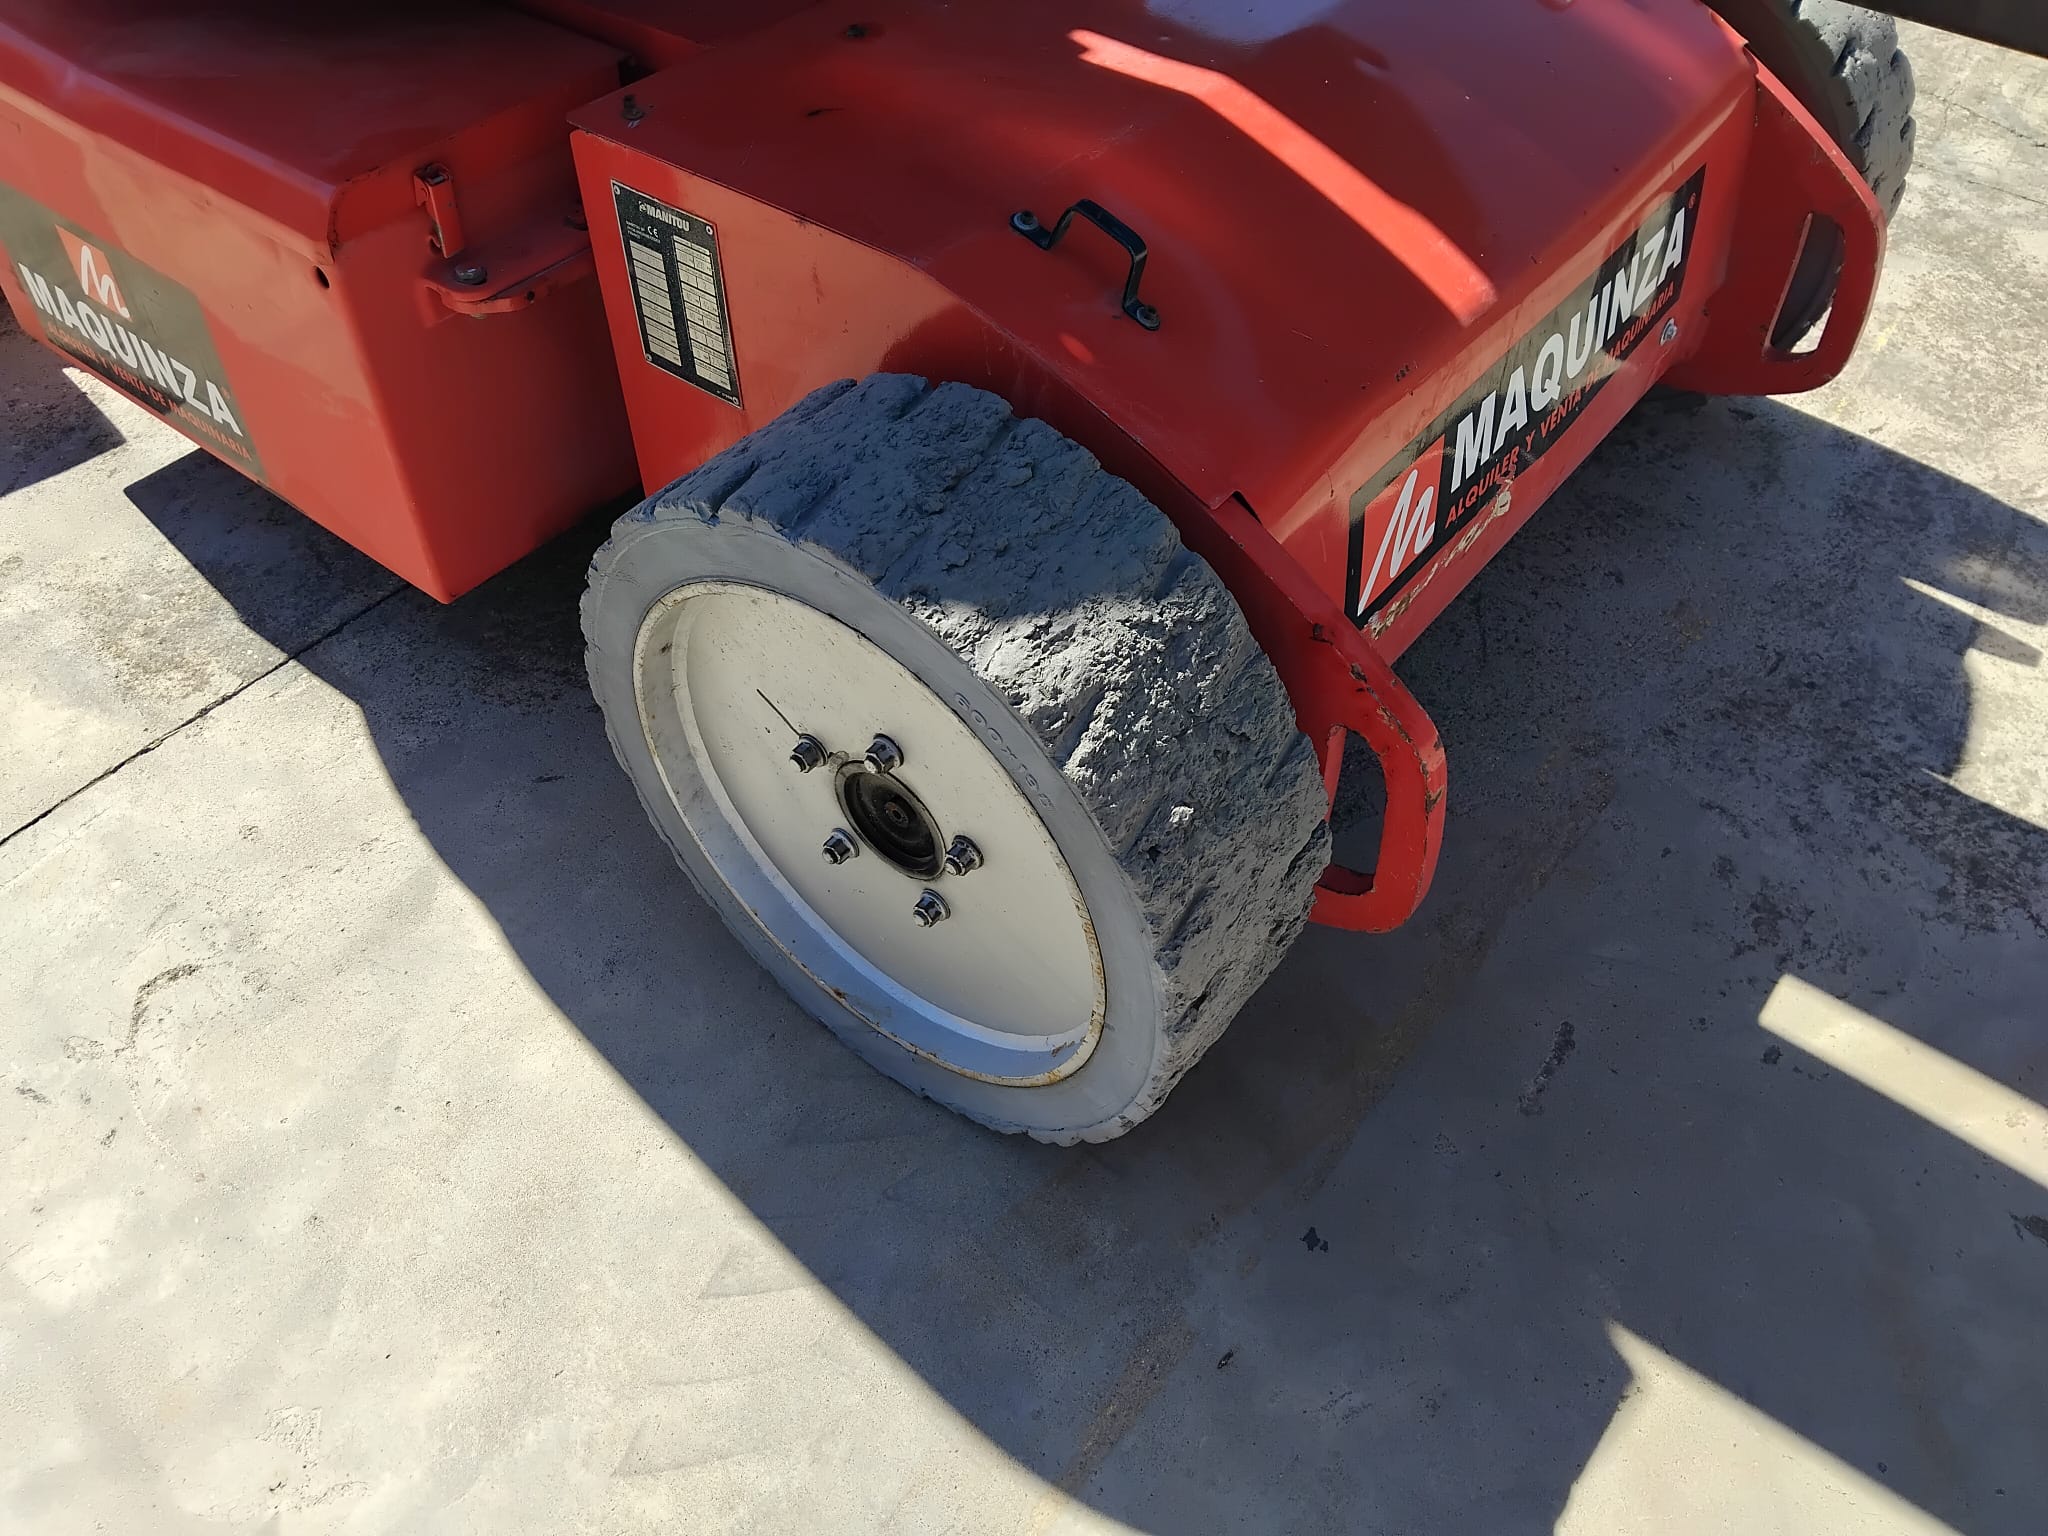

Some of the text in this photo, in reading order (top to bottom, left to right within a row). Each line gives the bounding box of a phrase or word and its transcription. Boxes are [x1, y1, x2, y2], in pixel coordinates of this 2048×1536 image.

[646, 204, 690, 231] MANITOU
[647, 226, 659, 238] CE
[18, 262, 243, 437] MAQUINZA
[112, 362, 149, 395] VENTA
[151, 388, 167, 406] DE
[169, 400, 253, 461] MAQUINARIA
[1446, 446, 1519, 529] ALQUILER
[1525, 429, 1536, 452] Y
[1540, 392, 1582, 439] VENTA
[1605, 281, 1675, 362] MAQUINARIA
[1451, 207, 1686, 494] MAQUINZA
